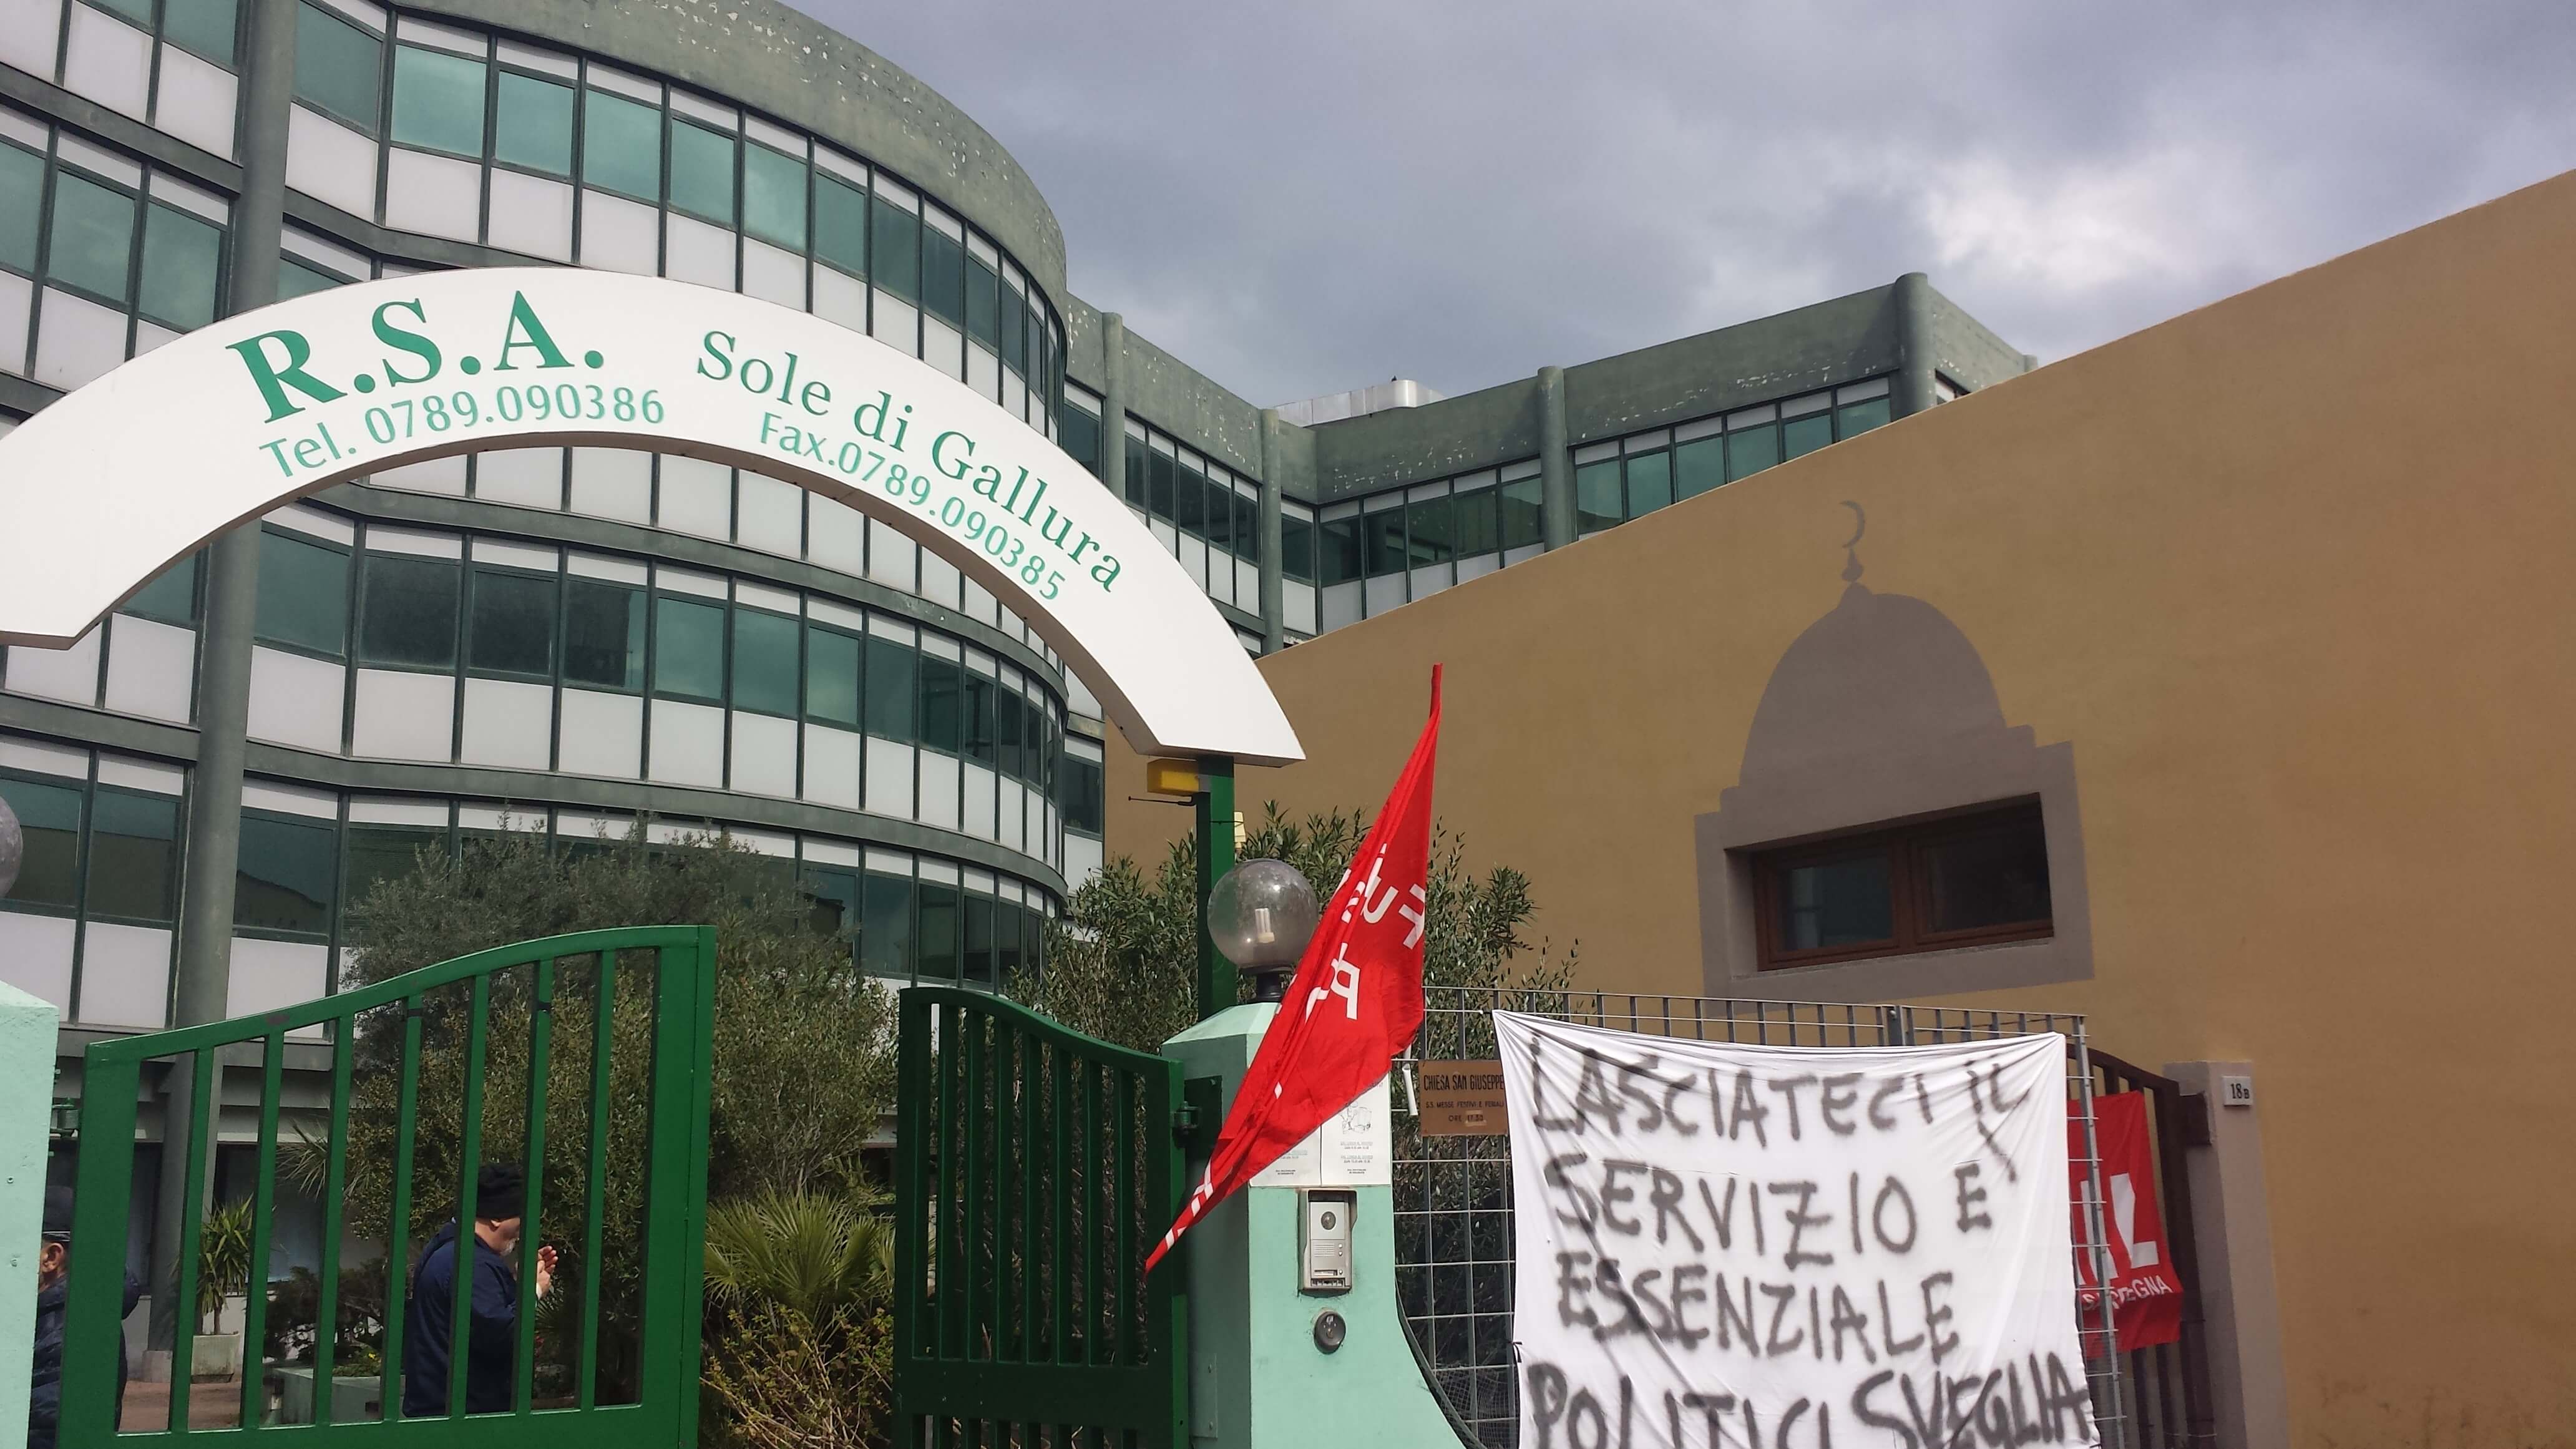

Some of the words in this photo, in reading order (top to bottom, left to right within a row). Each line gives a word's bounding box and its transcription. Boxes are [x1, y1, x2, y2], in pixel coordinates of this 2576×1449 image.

[226, 290, 604, 424] R.S.A.
[259, 422, 357, 478] Tel.
[364, 383, 665, 444] 0789.090386
[696, 330, 831, 416] Sole
[854, 390, 913, 452] di
[931, 431, 1121, 593] Gallura
[1423, 1075, 1450, 1091] CHIESA
[1453, 1075, 1467, 1090] SAN
[1470, 1075, 1505, 1090] GIUSEPPE
[1529, 1033, 1933, 1149] LASCIATECI
[1543, 1152, 1917, 1272] SERVIZIO
[1556, 1251, 1961, 1365] ESSENZIALE
[1851, 1350, 2095, 1449] SVEGLIA
